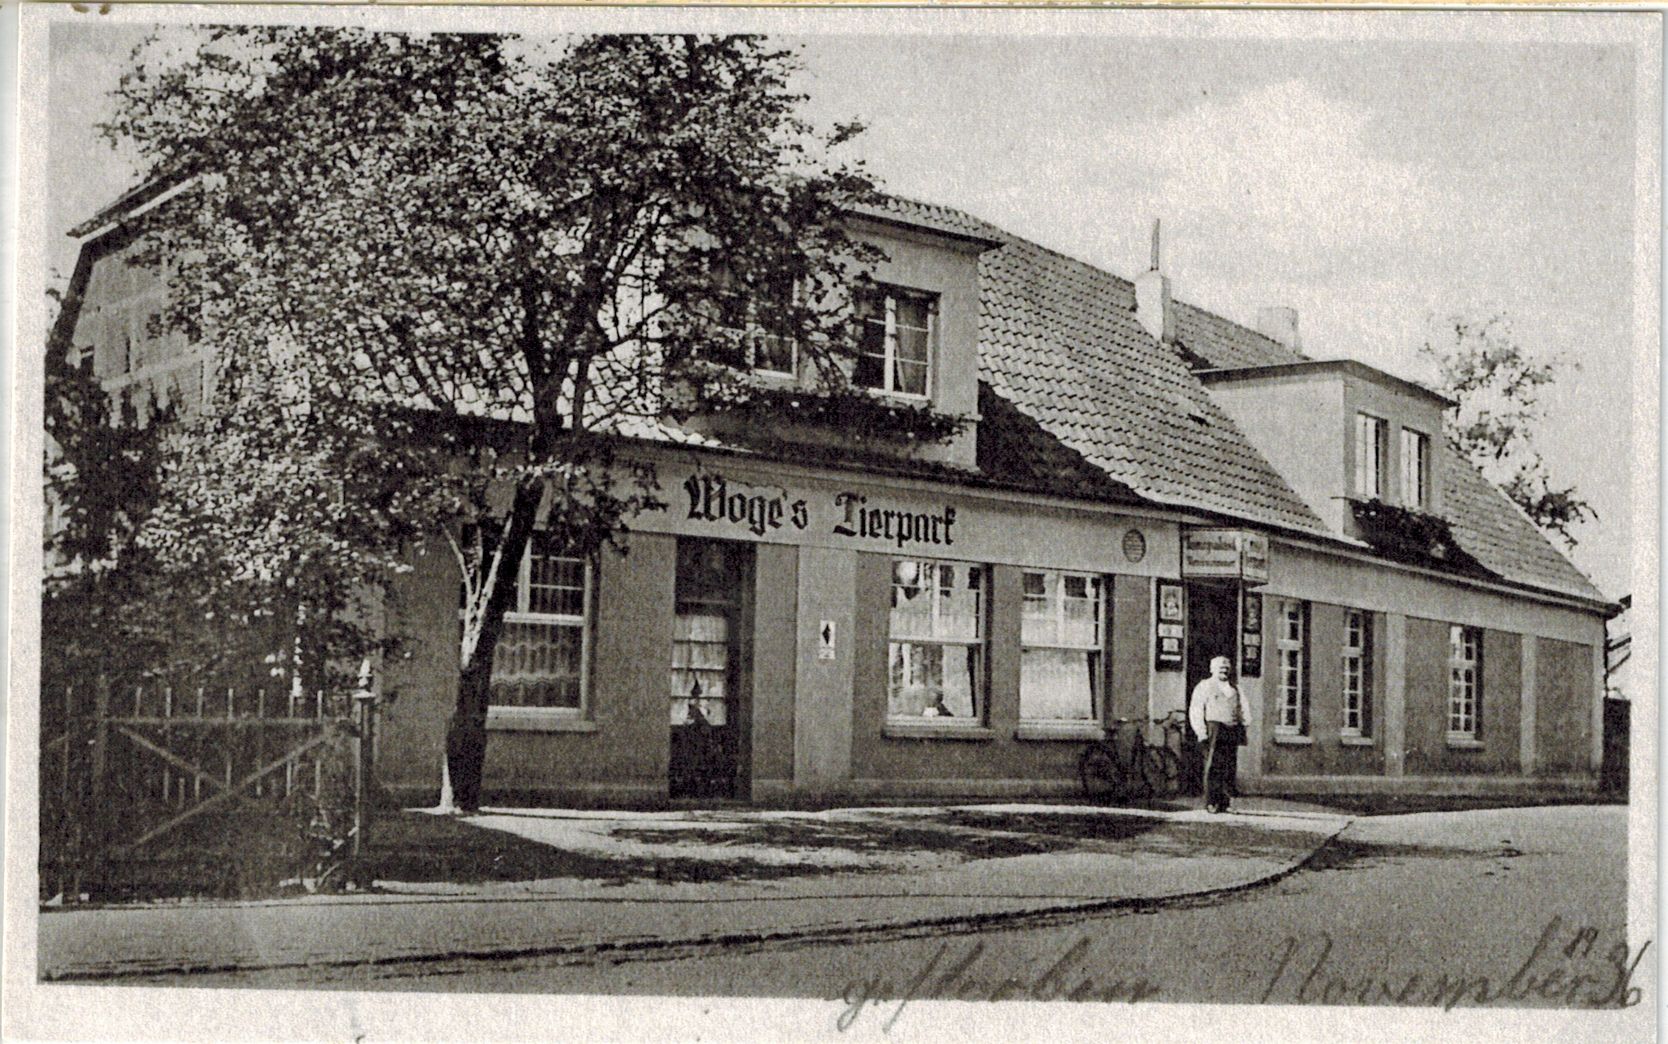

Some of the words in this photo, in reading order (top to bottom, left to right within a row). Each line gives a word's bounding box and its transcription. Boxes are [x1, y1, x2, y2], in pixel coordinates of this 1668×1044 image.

[683, 473, 808, 537] Woge's
[833, 491, 956, 548] Tierpark
[1261, 914, 1600, 1012] November
